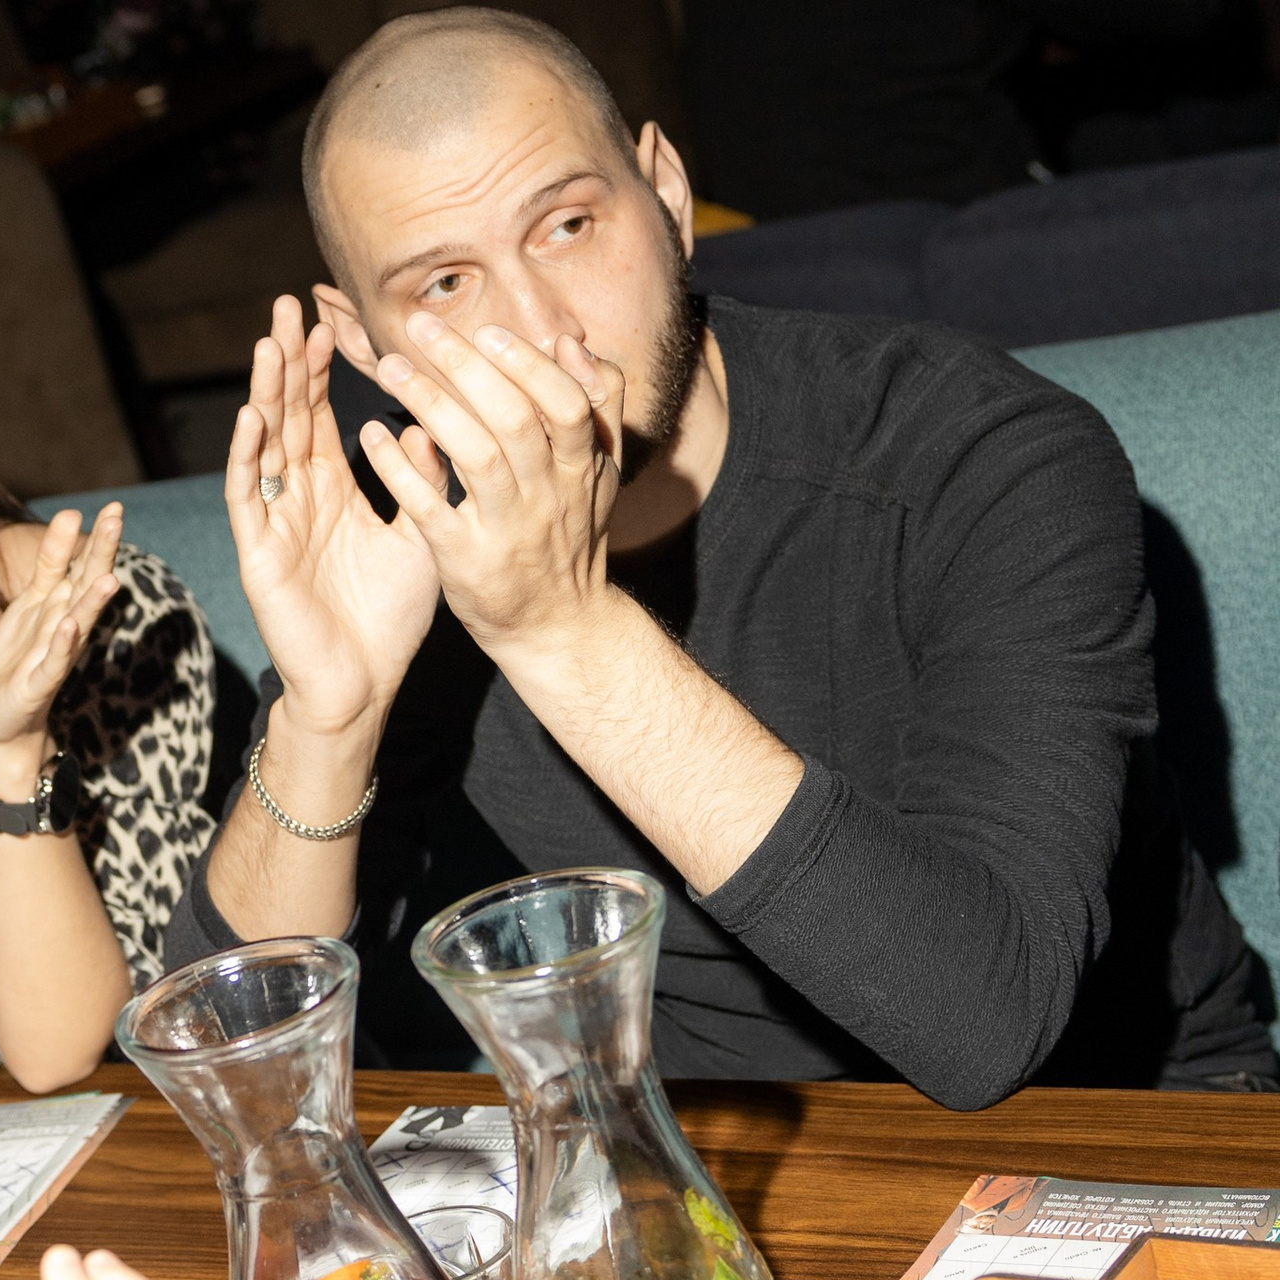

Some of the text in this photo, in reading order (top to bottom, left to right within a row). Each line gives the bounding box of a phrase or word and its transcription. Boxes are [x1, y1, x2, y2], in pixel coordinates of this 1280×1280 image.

[1048, 1193, 1081, 1201] ХОЧЕТСЯ
[1047, 1209, 1089, 1218] ПРАЗДНИКА
[1092, 1212, 1122, 1221] ВАШЕГО
[1212, 1209, 1260, 1217] АРХИТЕКТОР
[1165, 1216, 1202, 1224] ВЕДУЩИЙ
[1205, 1217, 1255, 1225] КРЕАТИВНЫЙ
[1024, 1218, 1153, 1239] АБДУЛЛИН
